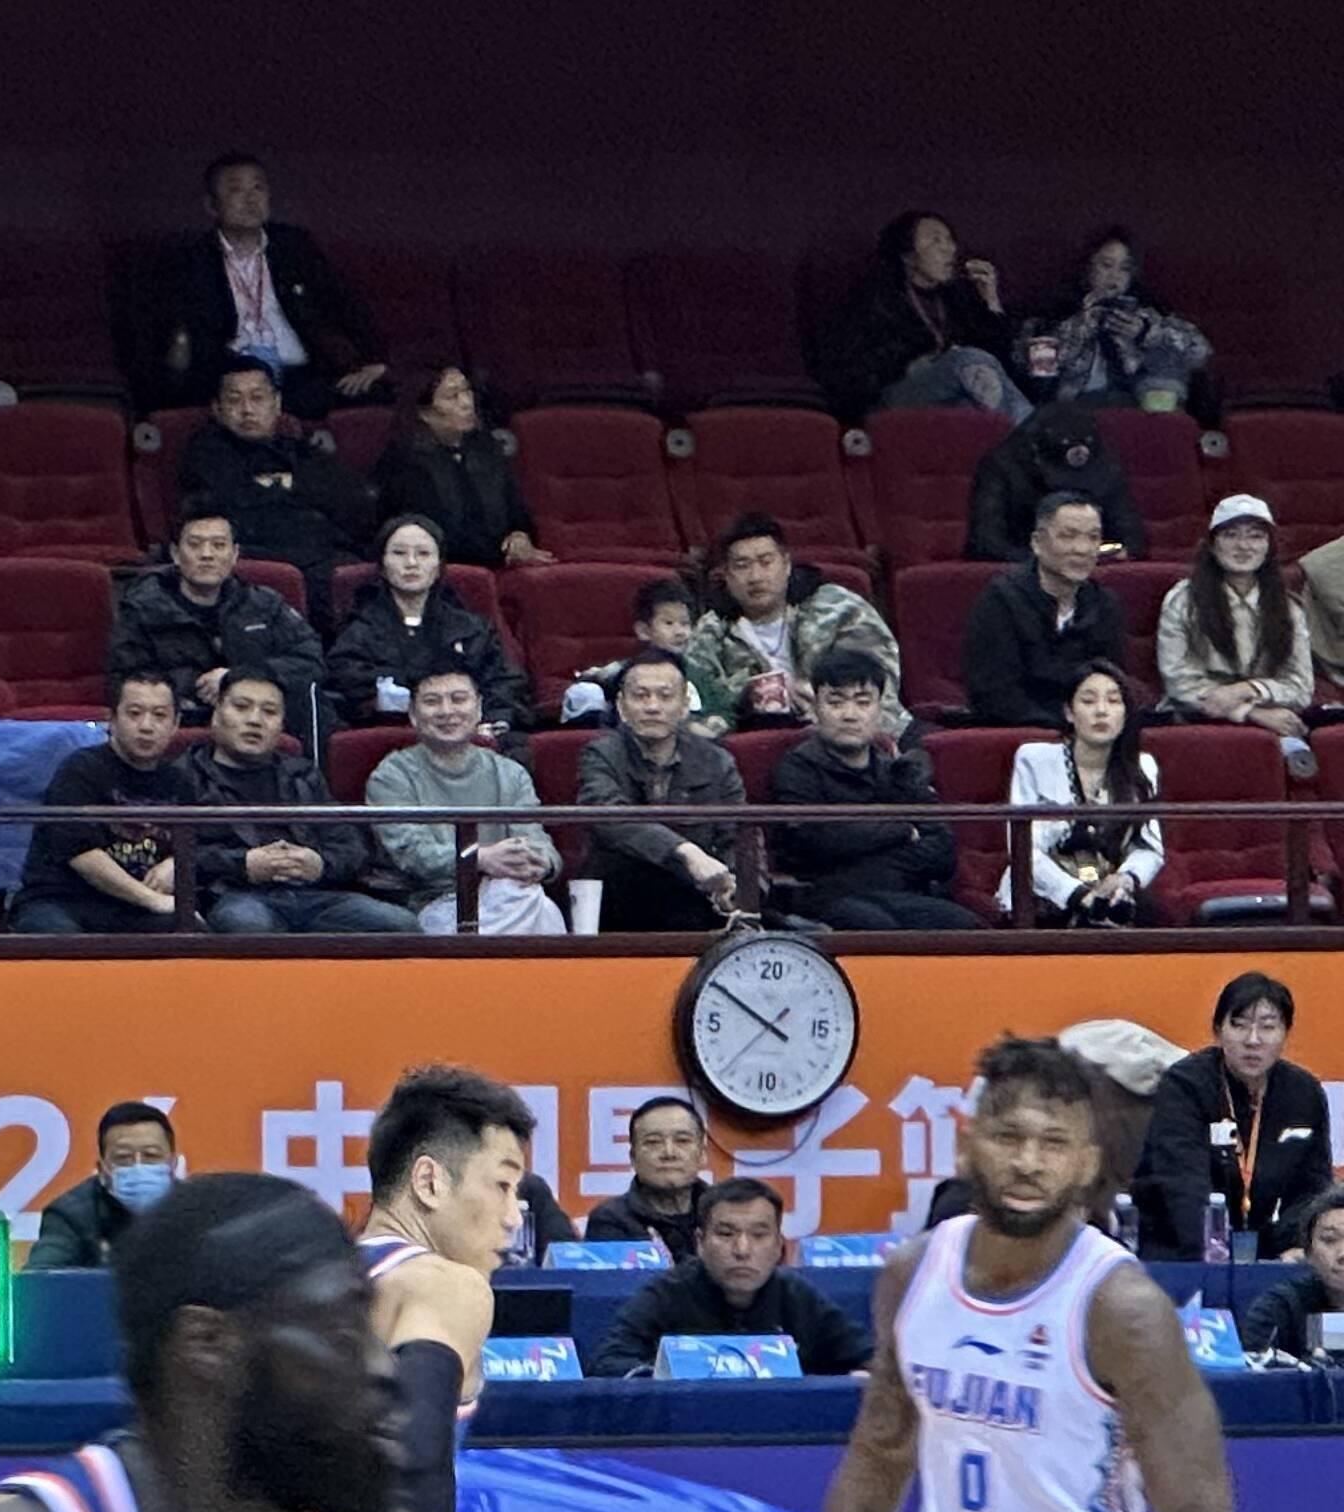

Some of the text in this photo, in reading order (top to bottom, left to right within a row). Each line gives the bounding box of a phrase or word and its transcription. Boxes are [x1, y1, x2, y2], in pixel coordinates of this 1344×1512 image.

[760, 960, 783, 981] 20
[708, 1012, 721, 1033] 5
[811, 1019, 830, 1039] 15
[757, 1071, 777, 1091] 10
[958, 1448, 989, 1512] 0
